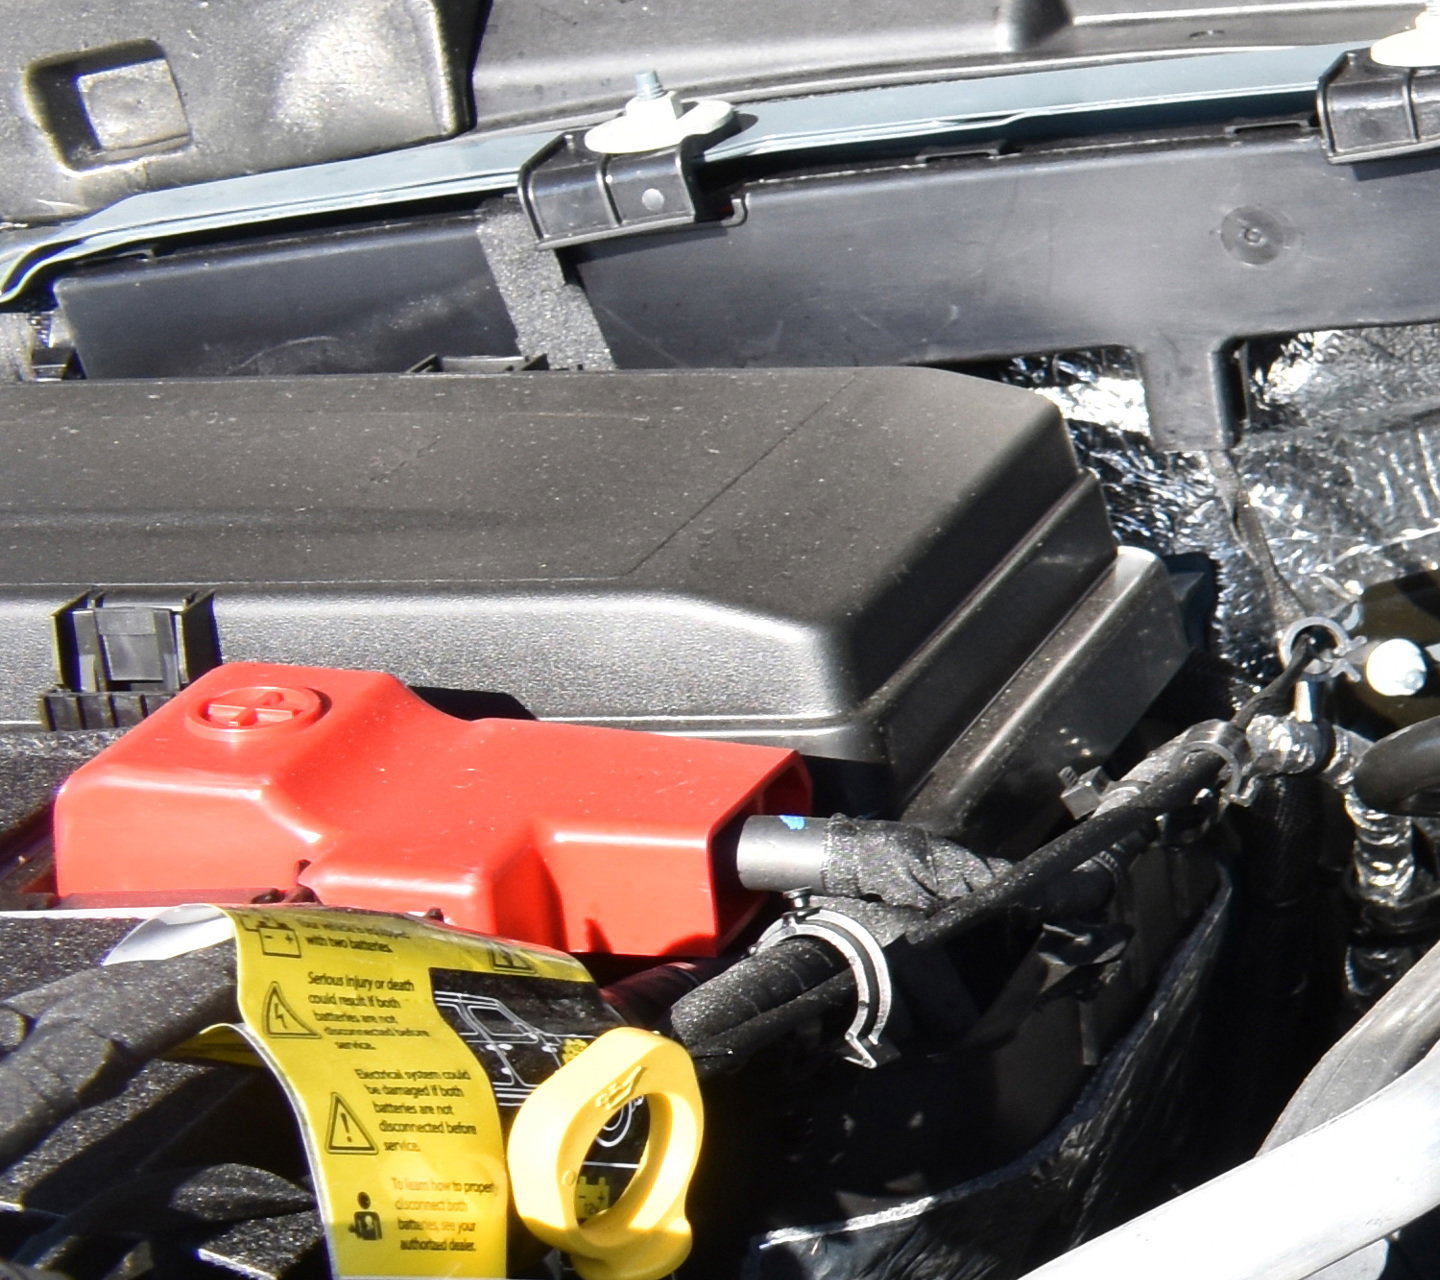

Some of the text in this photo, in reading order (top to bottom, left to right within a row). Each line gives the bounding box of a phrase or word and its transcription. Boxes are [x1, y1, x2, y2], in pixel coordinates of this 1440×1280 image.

[305, 935, 328, 947] with
[328, 937, 348, 949] two
[308, 971, 344, 986] Serious
[374, 980, 385, 989] or
[387, 978, 415, 991] death
[308, 993, 337, 1005] could
[337, 994, 368, 1007] result
[375, 996, 401, 1009] both
[313, 1009, 360, 1023] batteries
[361, 1014, 378, 1024] are
[354, 1068, 472, 1081] Electrical system could
[363, 1084, 381, 1095] be
[382, 1085, 430, 1099] damaged
[439, 1085, 464, 1097] both
[372, 1101, 454, 1116] batteries are not
[379, 1119, 477, 1135] disconnected before
[392, 1177, 404, 1191] To
[452, 1181, 463, 1192] to
[441, 1222, 456, 1231] see
[457, 1222, 476, 1235] your
[400, 1236, 477, 1252] authorized dealer.
